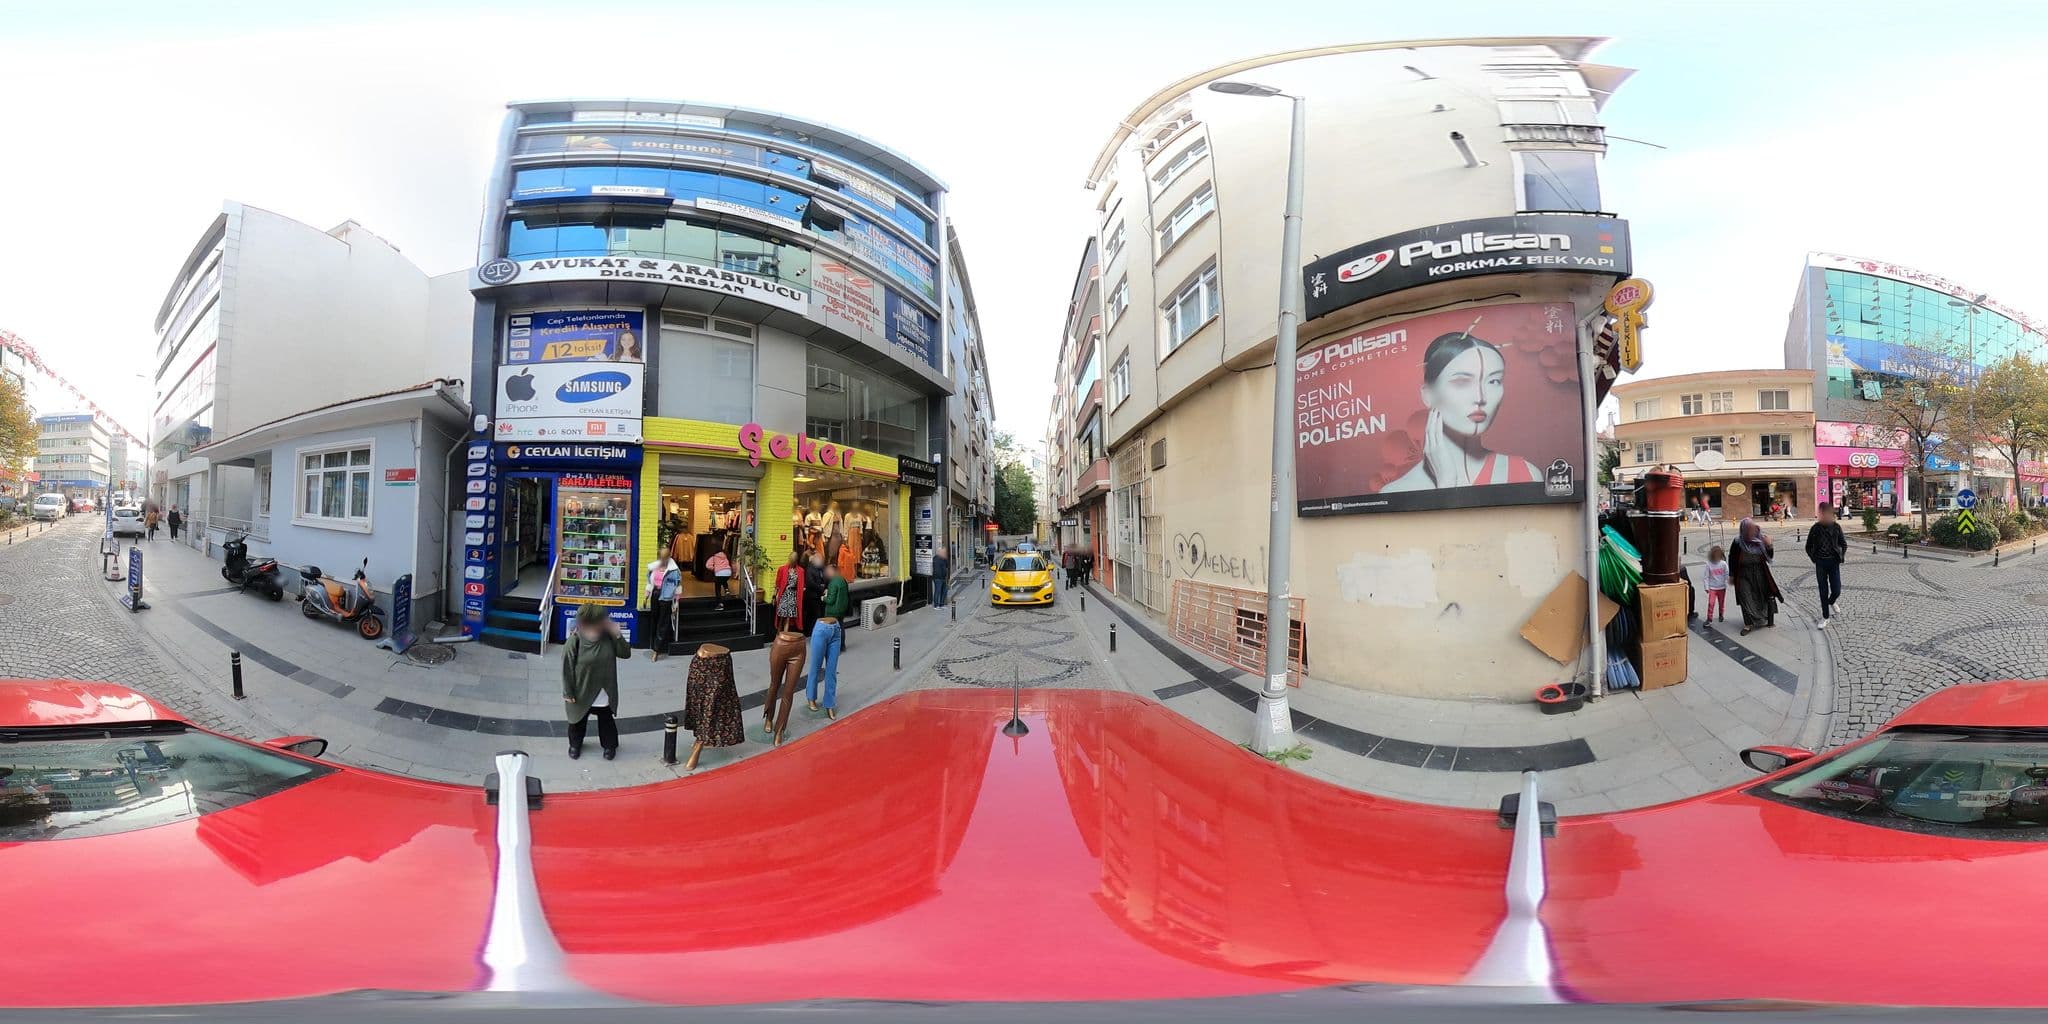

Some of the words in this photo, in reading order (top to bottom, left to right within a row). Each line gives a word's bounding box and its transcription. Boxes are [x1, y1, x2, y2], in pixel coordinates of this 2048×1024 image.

[1399, 232, 1571, 267] Polisan
[1429, 256, 1523, 277] KORKMAZ
[1574, 256, 1615, 267] YAPI
[529, 258, 630, 271] AVUKAT
[639, 260, 658, 270] &
[667, 262, 801, 301] ARABULUCU
[600, 269, 663, 280] Didem
[670, 274, 744, 294] ARSLAN
[540, 324, 578, 336] Kredili
[547, 318, 564, 326] Cep
[551, 343, 572, 358] 12
[1324, 329, 1407, 364] Polisan
[1296, 368, 1326, 383] HOME
[1331, 345, 1408, 371] COSMETICS
[565, 381, 622, 393] SAMSUNG
[505, 404, 538, 413] iPhone
[525, 447, 570, 457] CEYLAN
[575, 445, 627, 459] İLETİŞİM
[738, 423, 855, 469] Şeker
[1851, 454, 1878, 466] eve
